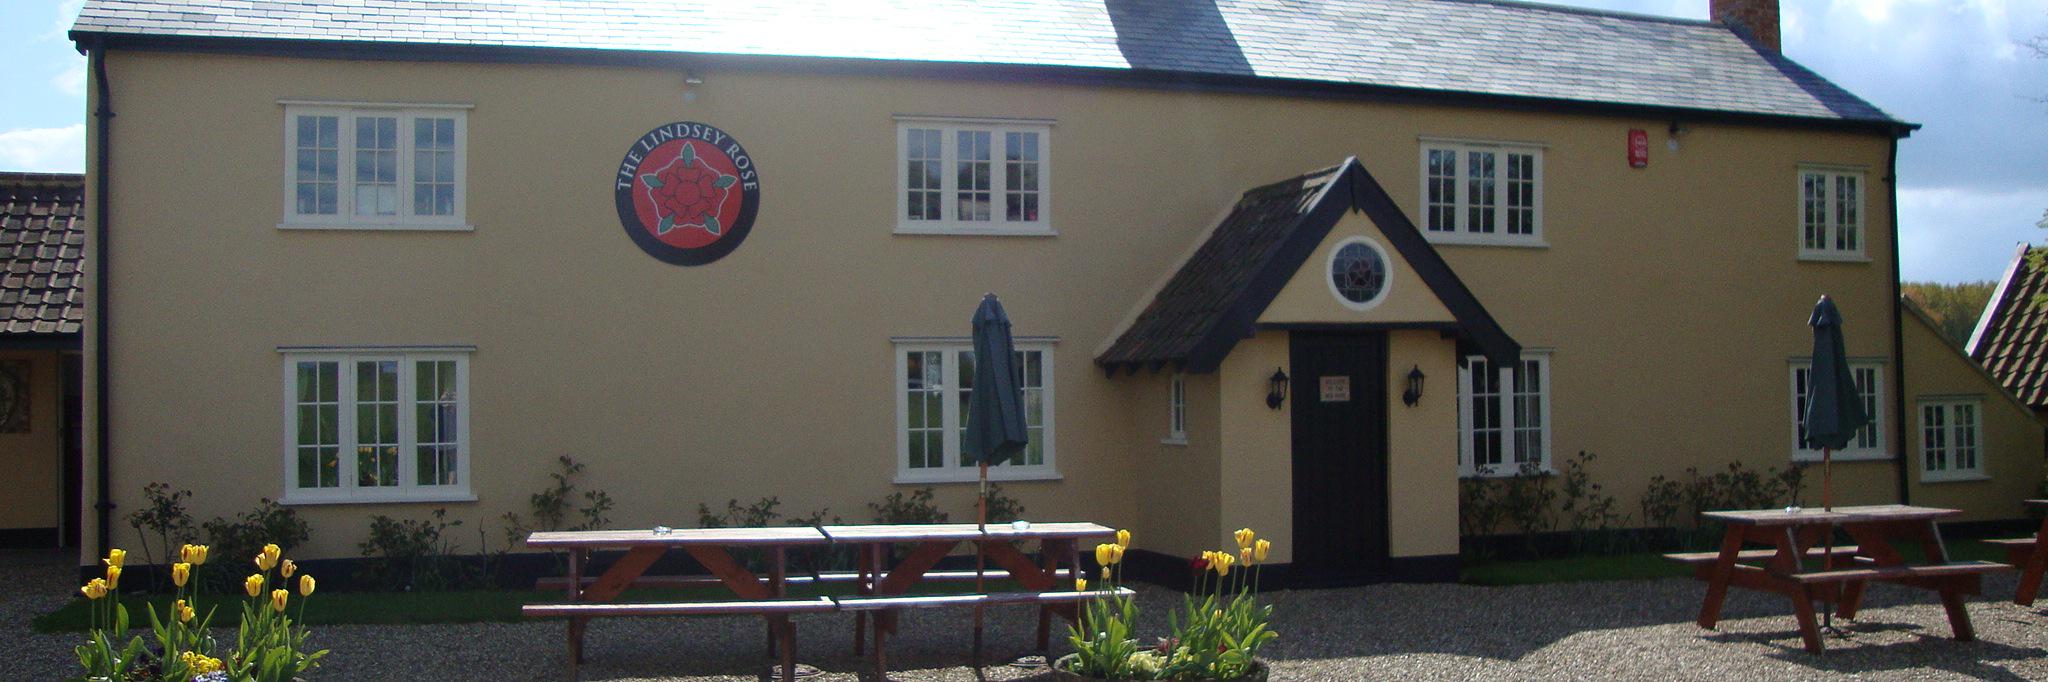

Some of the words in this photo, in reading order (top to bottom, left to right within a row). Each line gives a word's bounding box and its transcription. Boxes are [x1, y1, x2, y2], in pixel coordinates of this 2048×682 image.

[618, 151, 642, 190] THE
[642, 124, 726, 151] LINDSEY
[726, 144, 757, 191] ROSE
